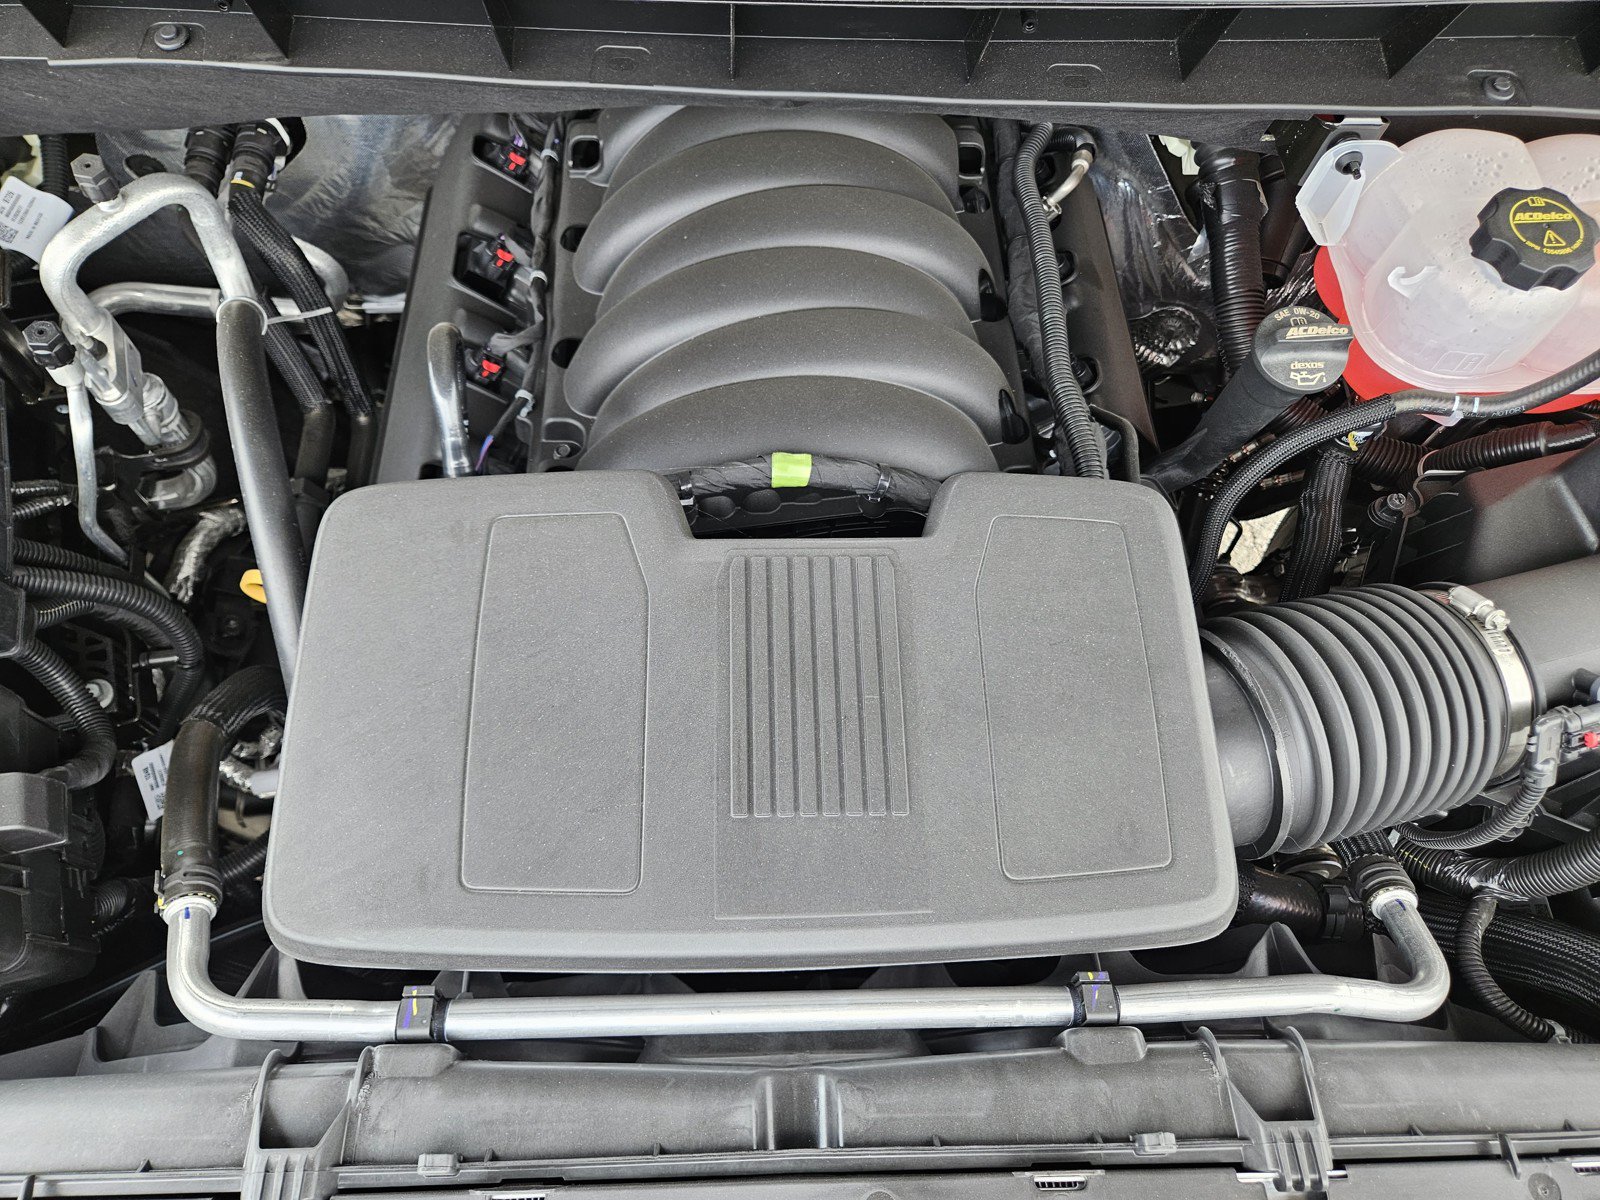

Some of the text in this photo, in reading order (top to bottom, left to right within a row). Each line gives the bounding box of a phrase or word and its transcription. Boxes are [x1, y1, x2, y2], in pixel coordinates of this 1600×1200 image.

[1514, 212, 1572, 221] ACDelco
[1274, 308, 1321, 321] SAE 0W-20
[1286, 326, 1349, 337] ACDelco
[1290, 361, 1325, 370] dexos
